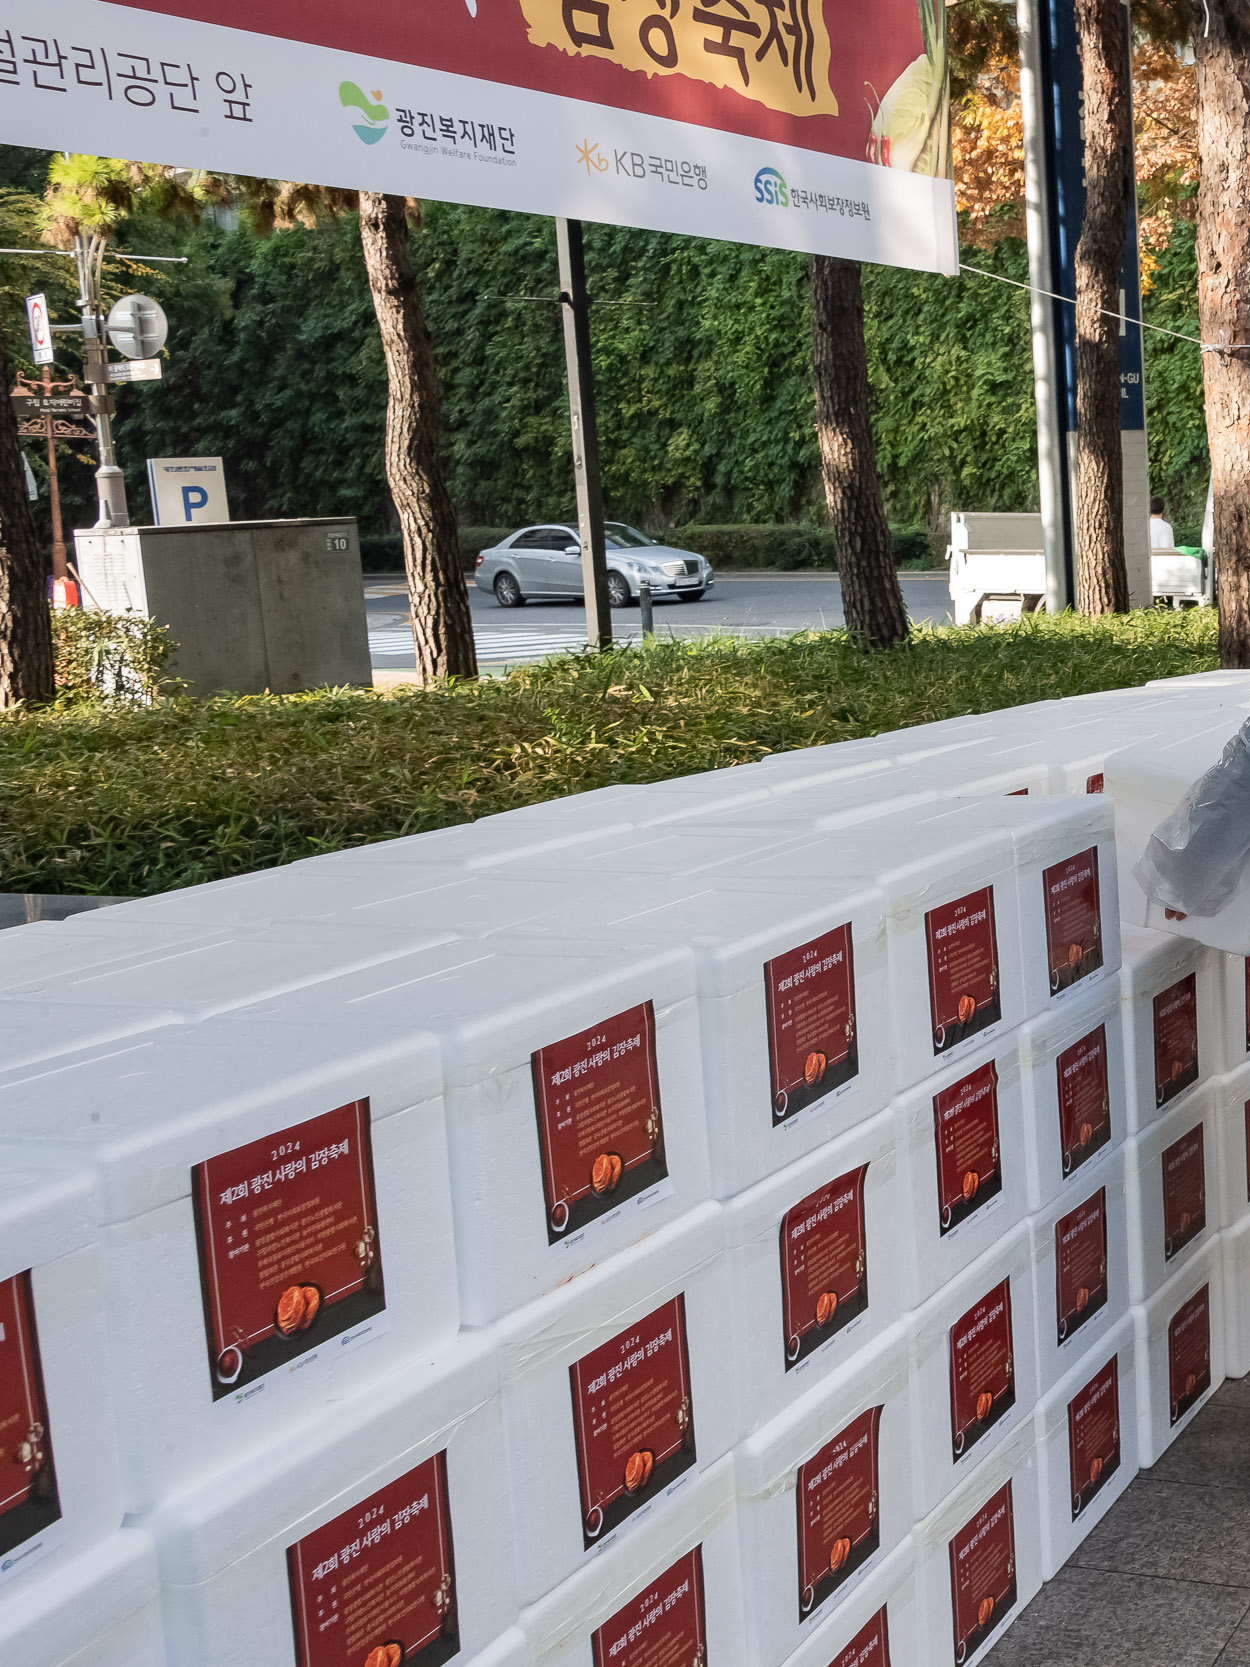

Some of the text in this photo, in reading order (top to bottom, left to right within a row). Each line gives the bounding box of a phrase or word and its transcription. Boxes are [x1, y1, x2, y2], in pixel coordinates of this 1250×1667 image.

[562, 0, 815, 101] 축제
[215, 71, 253, 122] 앞
[395, 107, 516, 155] 광진복지재단
[400, 139, 518, 167] Gwangjin Welfare Foundation
[790, 187, 871, 221] 한국사회보장정보원
[181, 485, 208, 521] P
[333, 538, 347, 550] 10
[550, 1033, 640, 1085] 제2회 광진 사랑의 김장축제
[586, 1034, 606, 1050] 2024
[270, 1140, 300, 1160] 2024
[219, 1138, 348, 1204] 제2회 광진 사랑의 김장축제
[587, 1327, 672, 1394] 제2회 광진 사랑의 김장축제
[619, 1334, 639, 1354] 2024
[357, 1504, 384, 1528] 2024
[311, 1493, 428, 1580] 제2회 광진 사랑의 김장축제
